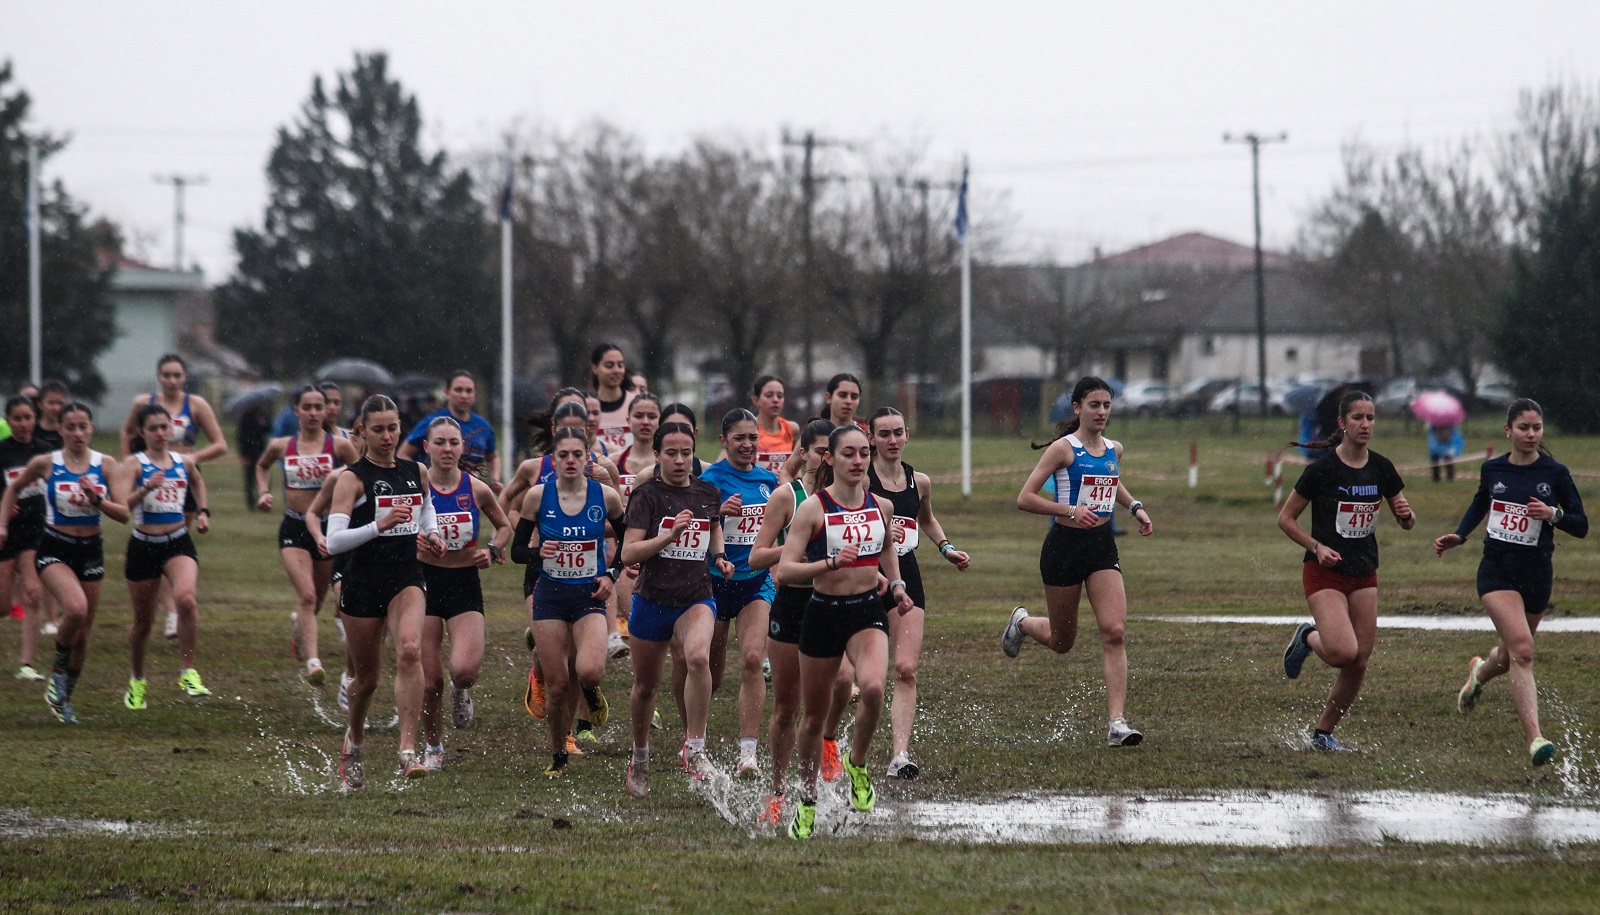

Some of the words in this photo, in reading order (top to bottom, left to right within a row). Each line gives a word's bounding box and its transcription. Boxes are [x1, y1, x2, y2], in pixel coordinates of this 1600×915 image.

[296, 466, 321, 480] 430
[1095, 478, 1113, 486] ERGO
[1090, 487, 1113, 502] 414
[1352, 485, 1378, 496] PUMA
[391, 497, 413, 507] EGO
[742, 507, 763, 517] ERGO
[1504, 504, 1528, 516] ERGO
[843, 513, 867, 524] ERGO
[1348, 513, 1374, 528] 419
[1500, 514, 1529, 533] 450
[440, 525, 460, 540] 13
[842, 523, 873, 544] 412
[559, 543, 583, 552] ERGO
[670, 549, 698, 558] ΣΕΓΑΣ
[556, 552, 585, 568] 416
